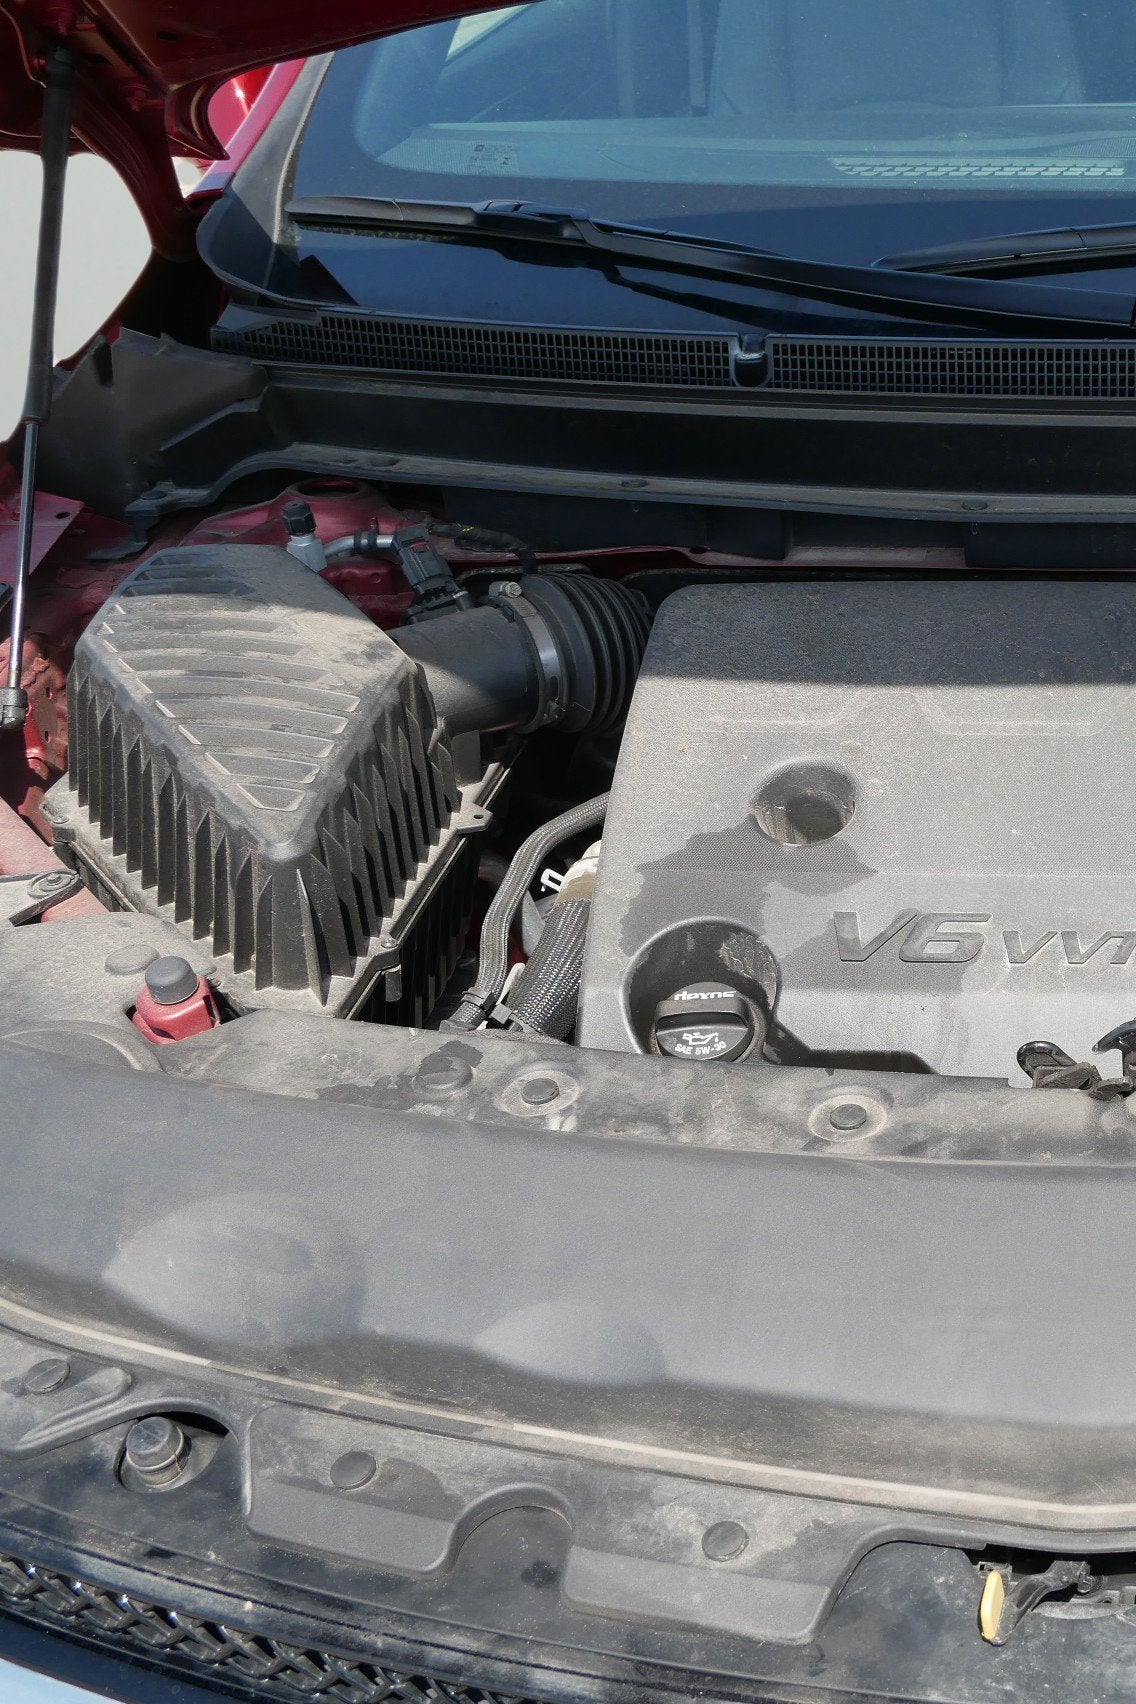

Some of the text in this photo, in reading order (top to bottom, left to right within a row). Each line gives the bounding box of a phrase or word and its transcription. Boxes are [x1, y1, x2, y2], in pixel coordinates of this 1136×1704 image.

[834, 911, 992, 963] V6
[675, 1041, 727, 1055] SAE 5W-30
